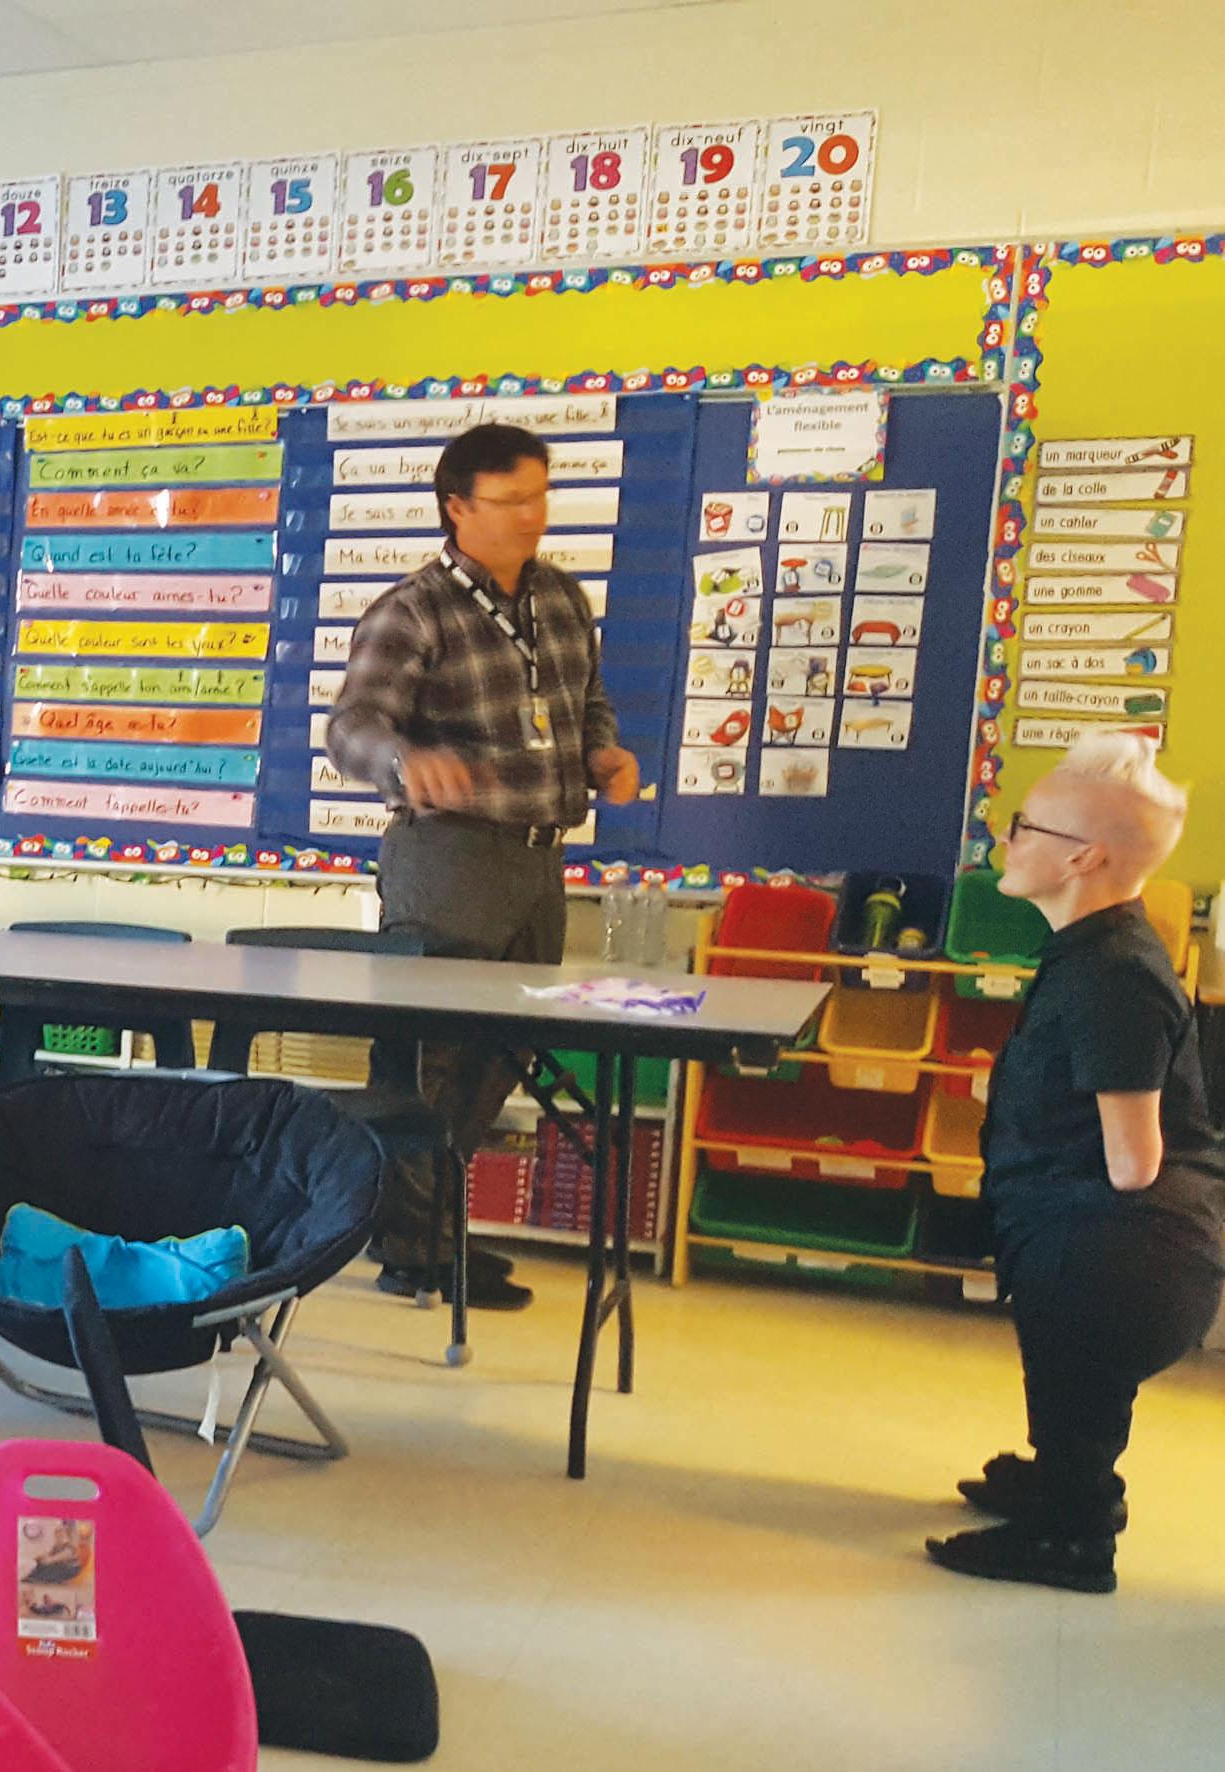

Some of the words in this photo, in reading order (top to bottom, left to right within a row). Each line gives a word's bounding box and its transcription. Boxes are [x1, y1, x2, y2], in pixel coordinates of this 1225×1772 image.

[800, 119, 844, 133] vingt
[371, 154, 412, 167] seize
[780, 134, 860, 178] 20
[270, 162, 318, 177] quinze
[570, 151, 622, 192] 18
[680, 144, 735, 186] 19
[367, 168, 414, 207] 16
[469, 163, 516, 200] 17
[178, 184, 221, 220] 14
[270, 179, 313, 215] 15
[88, 189, 128, 226] 13
[1, 201, 42, 237] 12
[767, 401, 869, 416] L'aménagement
[793, 420, 843, 432] flexible
[74, 430, 95, 446] que
[1045, 450, 1060, 461] un
[1066, 449, 1123, 463] marqueur
[38, 459, 129, 481] Comment
[142, 463, 159, 480] ça
[1042, 483, 1056, 496] de
[1063, 482, 1073, 495] la
[1079, 481, 1107, 495] colle
[1040, 517, 1054, 527] un
[1036, 550, 1055, 562] des
[1034, 586, 1054, 597] une
[1061, 586, 1103, 599] gomme
[1028, 623, 1043, 634] un
[1048, 622, 1090, 637] crayon
[25, 631, 68, 648] Quelle
[1027, 658, 1041, 669] un
[1047, 659, 1065, 669] sac
[1084, 656, 1105, 669] dos
[1024, 691, 1038, 701] un
[39, 711, 78, 729] Quel
[1022, 728, 1043, 739] une
[13, 788, 88, 809] Comment
